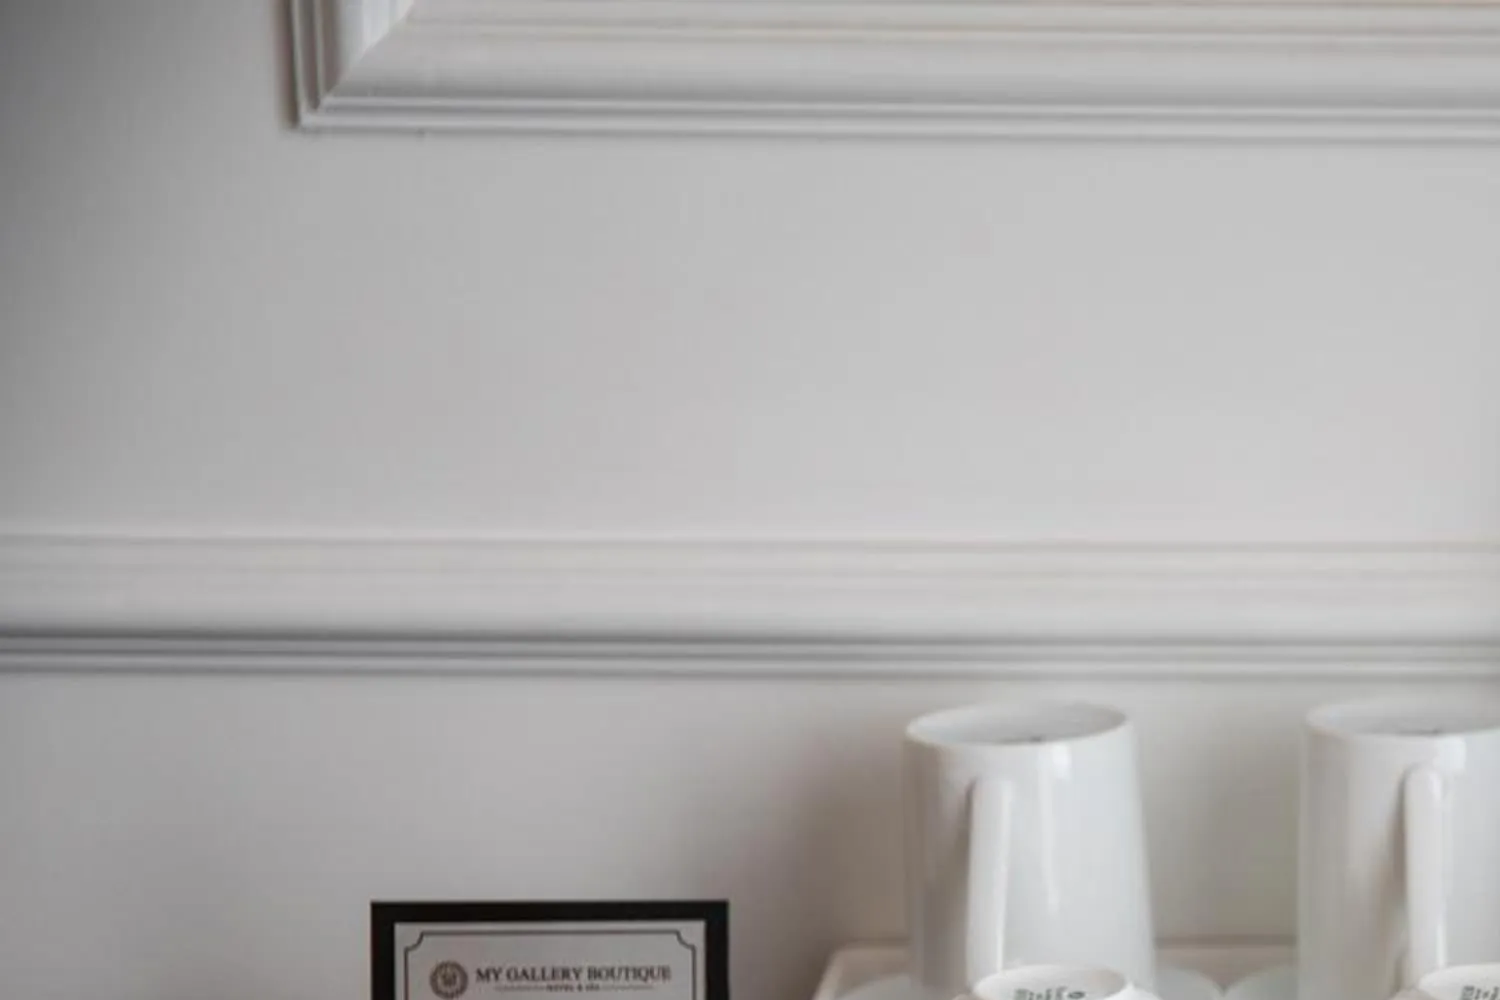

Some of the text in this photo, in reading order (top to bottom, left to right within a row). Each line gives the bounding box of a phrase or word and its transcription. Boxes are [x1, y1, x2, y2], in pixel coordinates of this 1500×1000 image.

[475, 964, 672, 983] MY GALLERY BOUTIQUE
